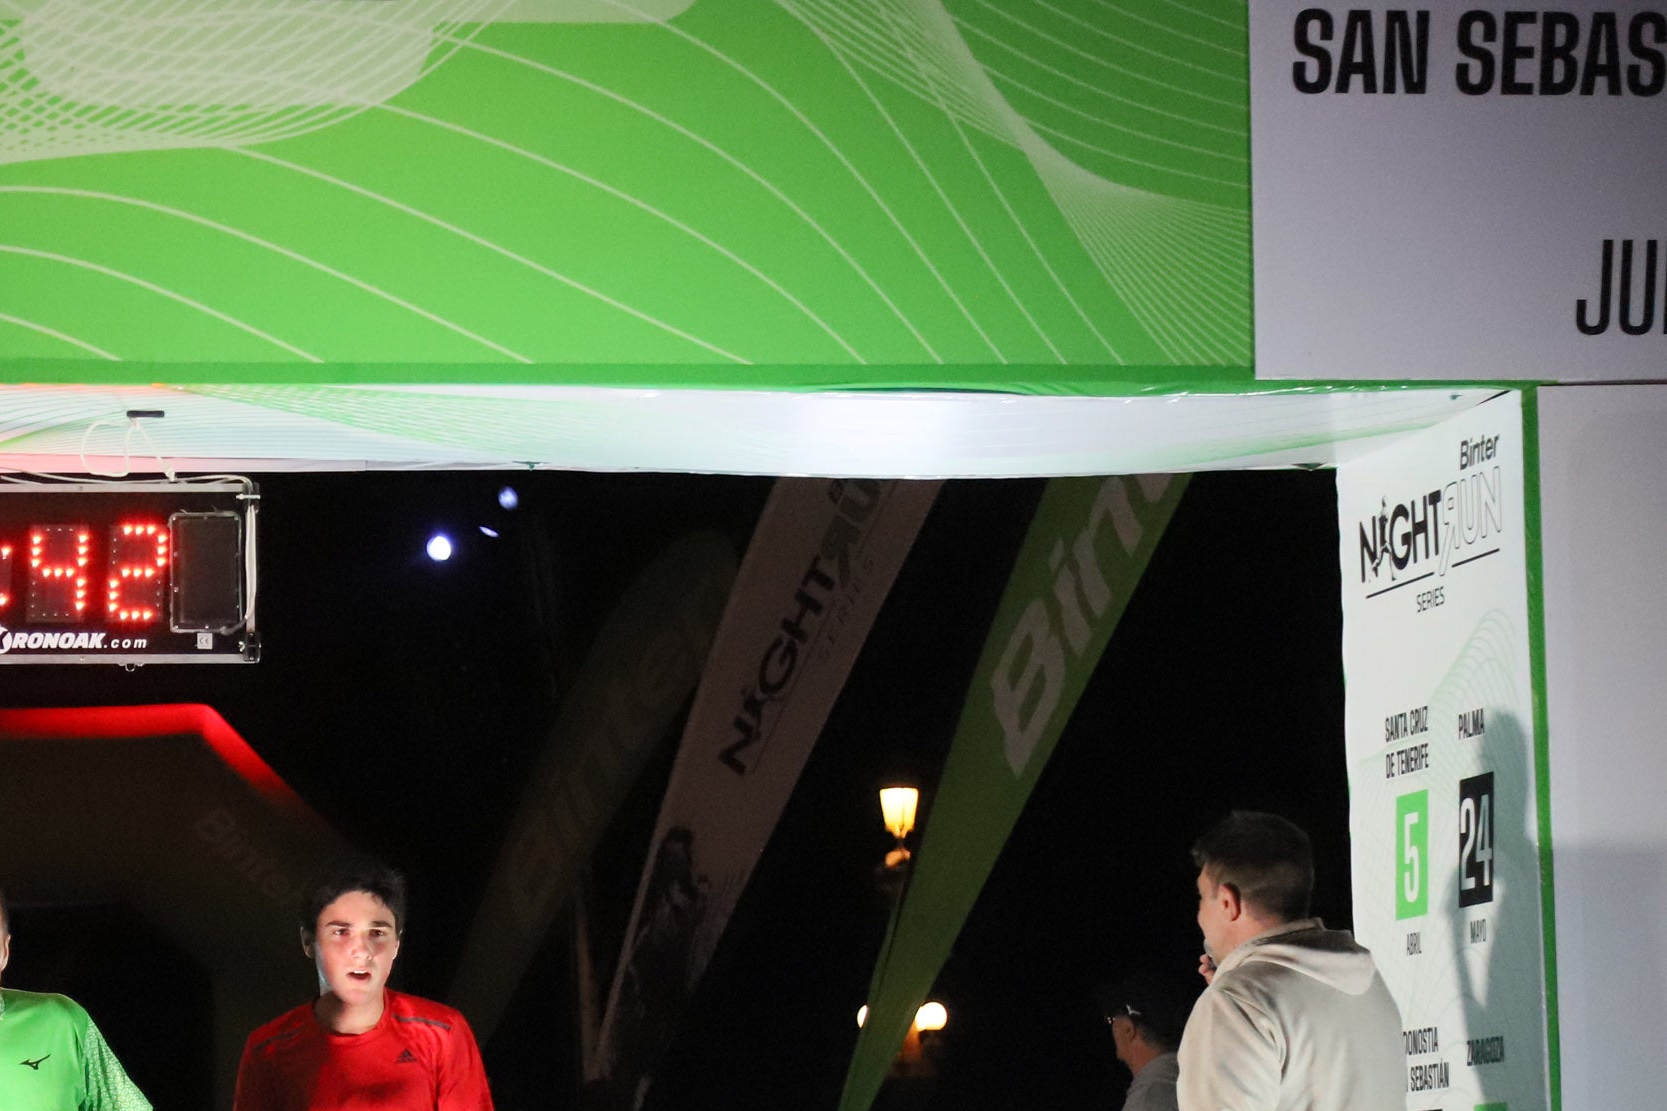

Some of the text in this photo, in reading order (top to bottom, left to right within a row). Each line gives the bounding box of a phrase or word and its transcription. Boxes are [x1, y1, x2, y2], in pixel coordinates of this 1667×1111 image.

[1292, 8, 1667, 97] SAN SEBAS
[1576, 239, 1667, 335] JU
[1460, 434, 1500, 471] Binter
[1416, 587, 1445, 613] SERIES
[990, 473, 1173, 780] Bin
[1385, 706, 1429, 743] SANTA CRUZ
[1458, 708, 1485, 740] PALMA
[1386, 743, 1429, 779] DE TENERIFE
[1404, 812, 1420, 903] 5
[1460, 794, 1492, 891] 24
[1406, 931, 1422, 955] ABRIL
[1470, 919, 1487, 944] MAYO
[1411, 1058, 1450, 1092] SEBASTIÁN
